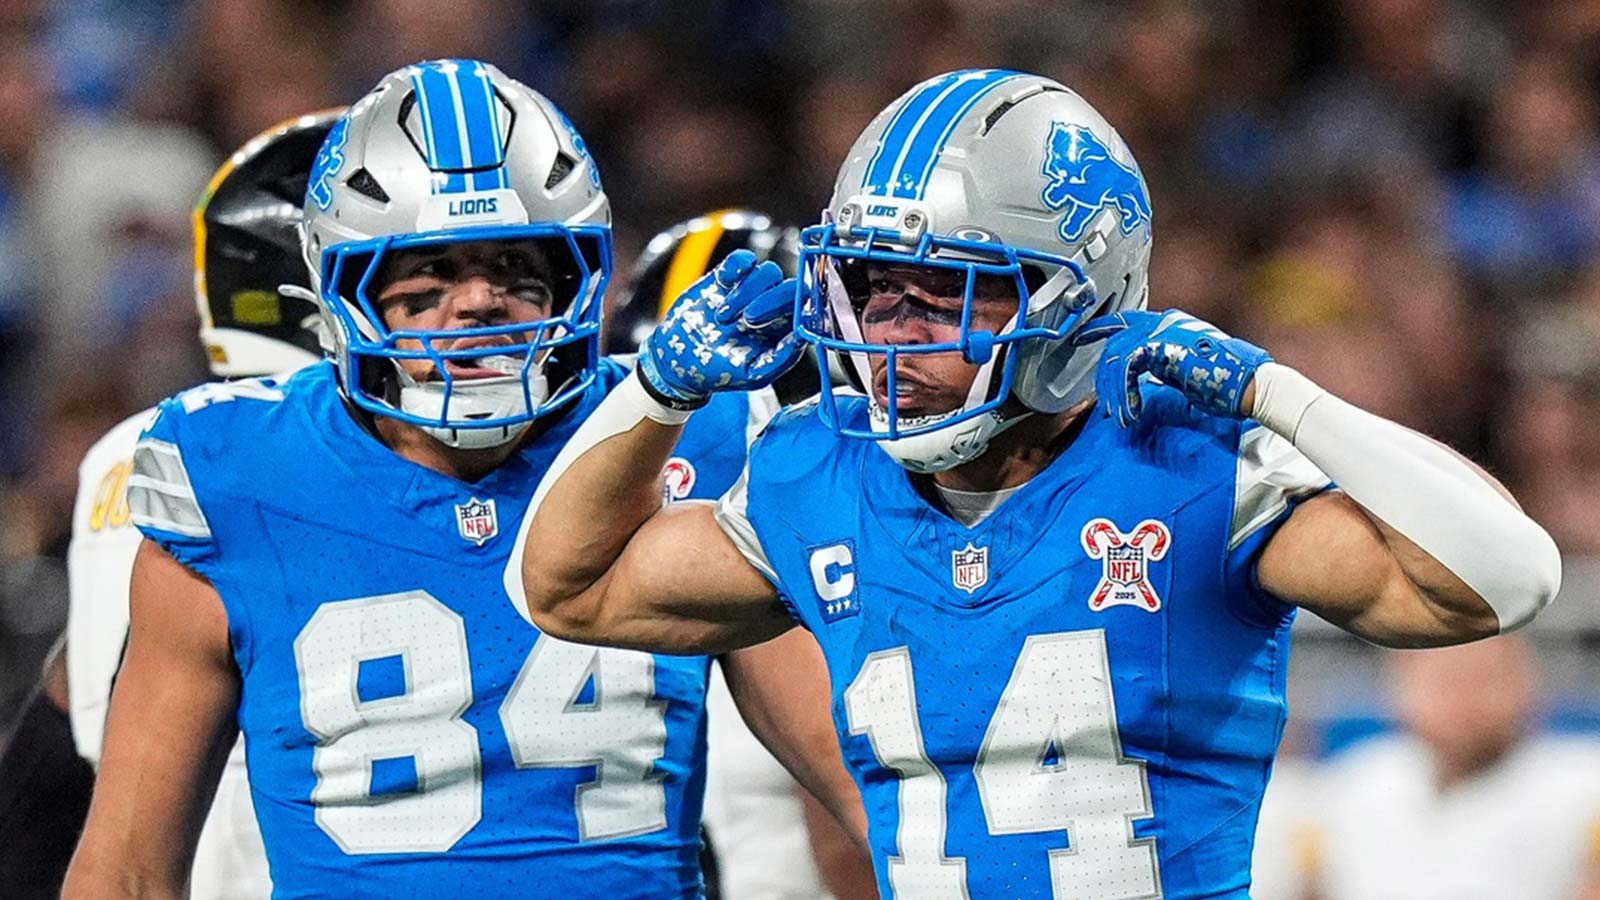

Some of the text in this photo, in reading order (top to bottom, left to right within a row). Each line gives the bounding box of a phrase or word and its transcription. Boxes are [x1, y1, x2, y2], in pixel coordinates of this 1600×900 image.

[448, 198, 498, 216] LIONS
[866, 204, 898, 217] LIONS
[465, 517, 494, 536] NFL
[810, 544, 855, 601] C
[959, 565, 982, 585] NFL
[1111, 561, 1140, 582] NFL
[1114, 591, 1136, 600] 2025
[293, 589, 668, 855] 84
[843, 628, 1163, 900] 14
